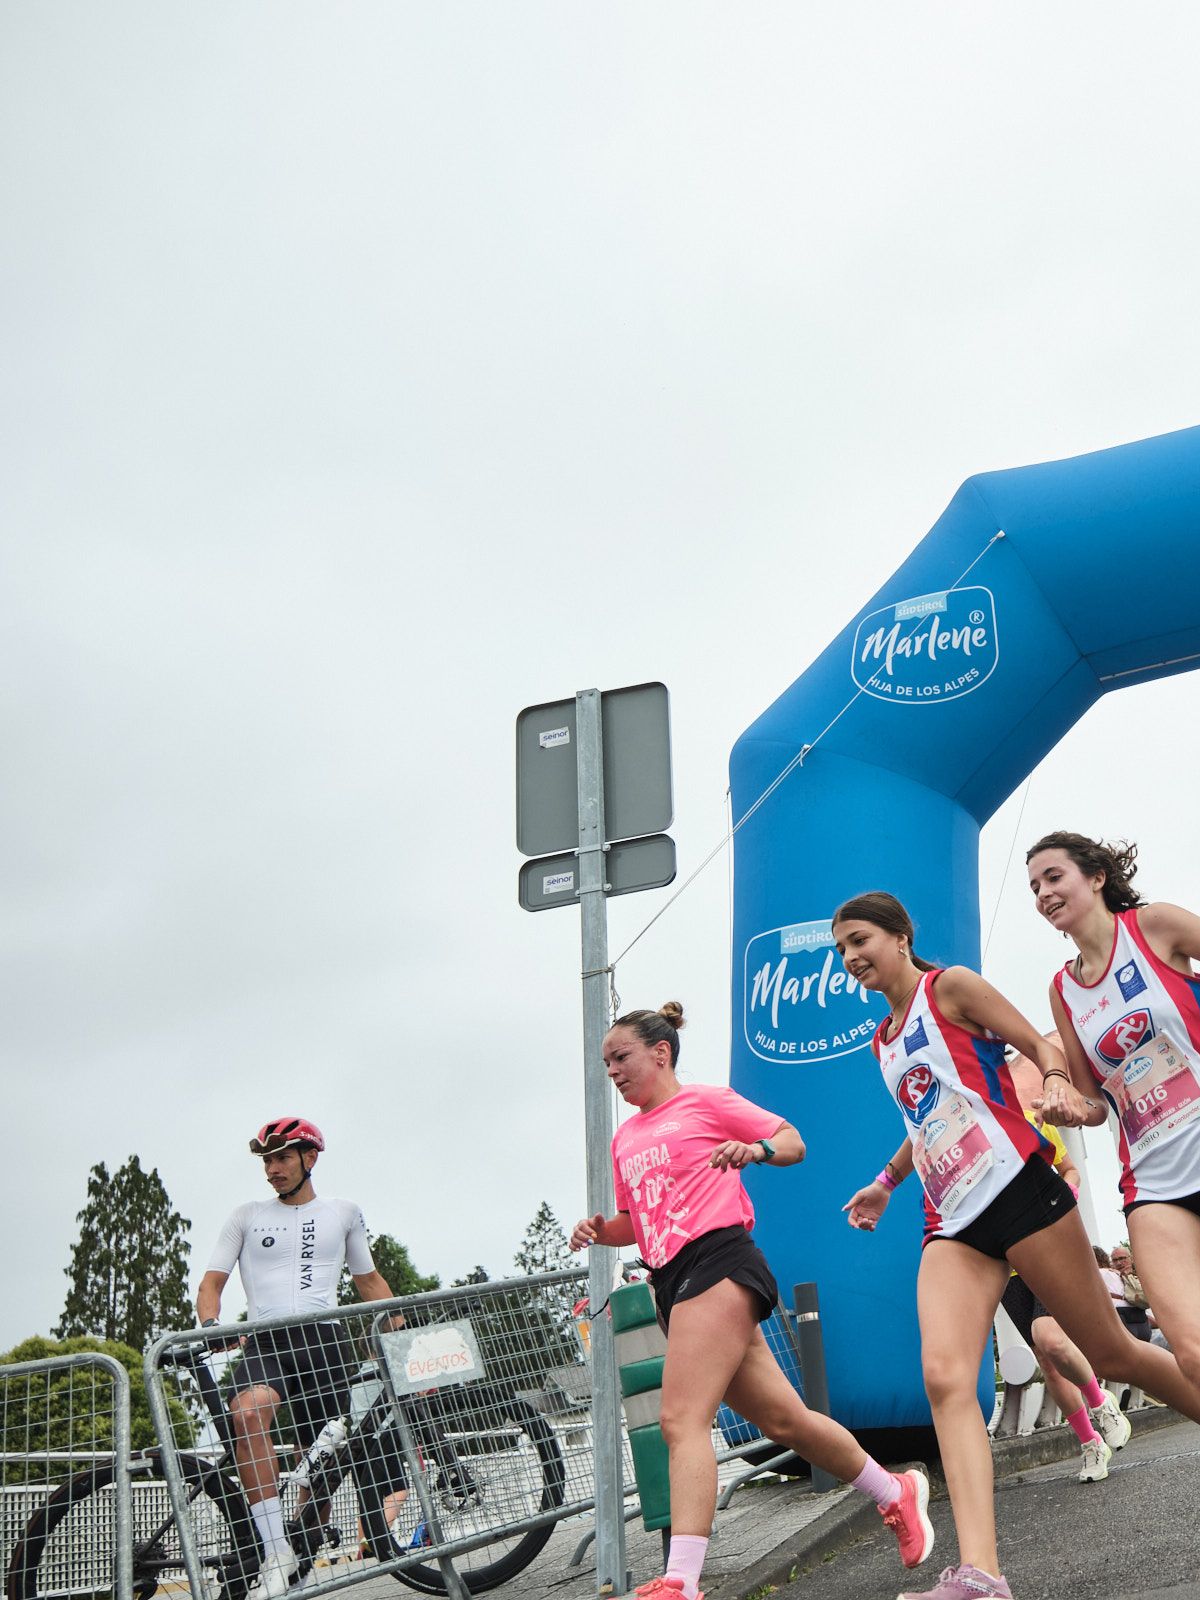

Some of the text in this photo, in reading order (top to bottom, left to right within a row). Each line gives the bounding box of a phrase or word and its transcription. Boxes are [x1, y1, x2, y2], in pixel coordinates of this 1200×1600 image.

[861, 615, 987, 675] Marlene
[868, 668, 980, 697] HIJA DE LOS ALPES
[543, 730, 569, 742] seinor
[546, 875, 573, 886] seinor
[751, 949, 884, 1029] Marlen
[755, 1018, 877, 1054] HIJA DE LOS ALPES
[1135, 1085, 1168, 1115] 016
[1173, 1105, 1200, 1126] Santander
[1137, 1130, 1160, 1151] OYSHO
[935, 1144, 964, 1175] 016
[943, 1189, 960, 1211] OYSHO
[300, 1218, 315, 1290] VAN RYSEL
[409, 1351, 468, 1376] EVENTOS
